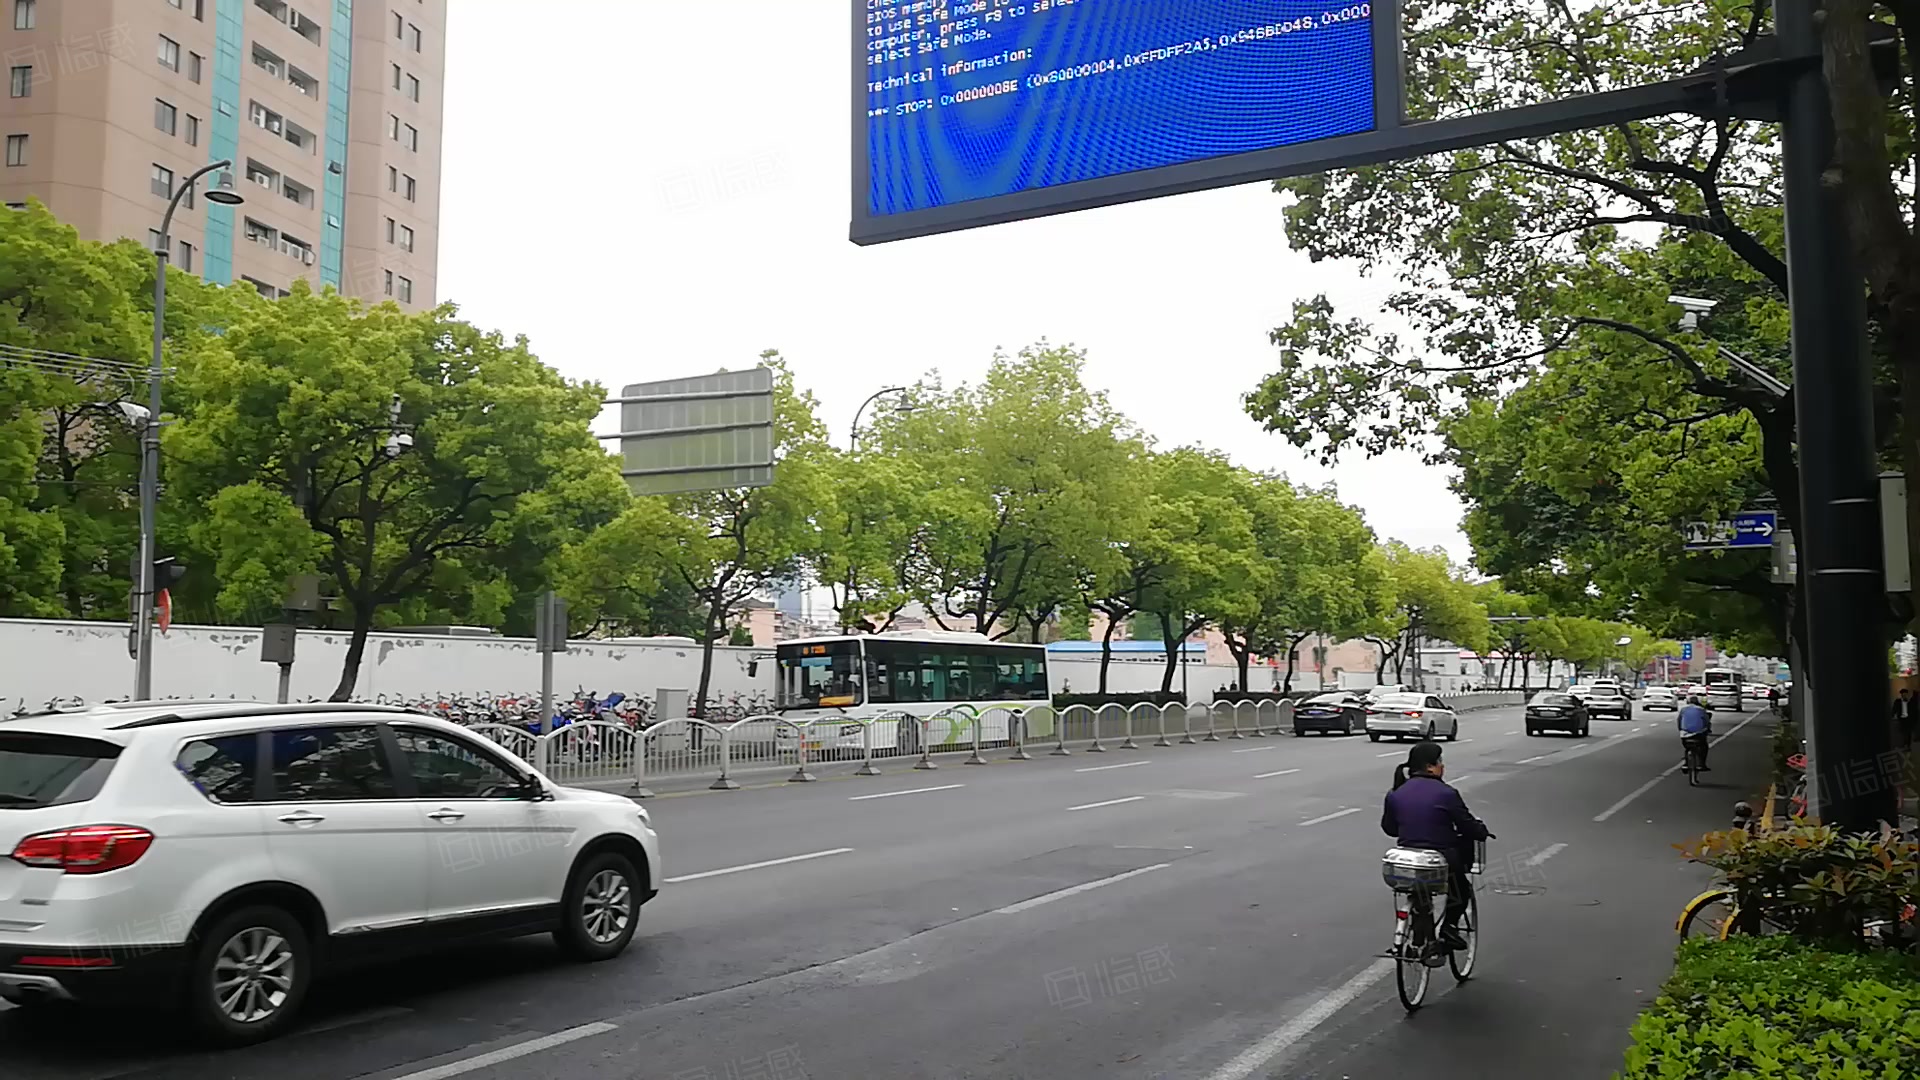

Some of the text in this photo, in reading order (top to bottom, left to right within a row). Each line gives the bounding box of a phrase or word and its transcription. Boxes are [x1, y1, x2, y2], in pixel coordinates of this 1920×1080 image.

[867, 26, 883, 37] to
[888, 18, 912, 32] use
[940, 17, 978, 37] press
[985, 9, 1002, 23] F8
[1008, 5, 1026, 18] to
[867, 46, 912, 66] select
[867, 47, 1033, 93] Technical information:
[896, 98, 933, 116] STOP:
